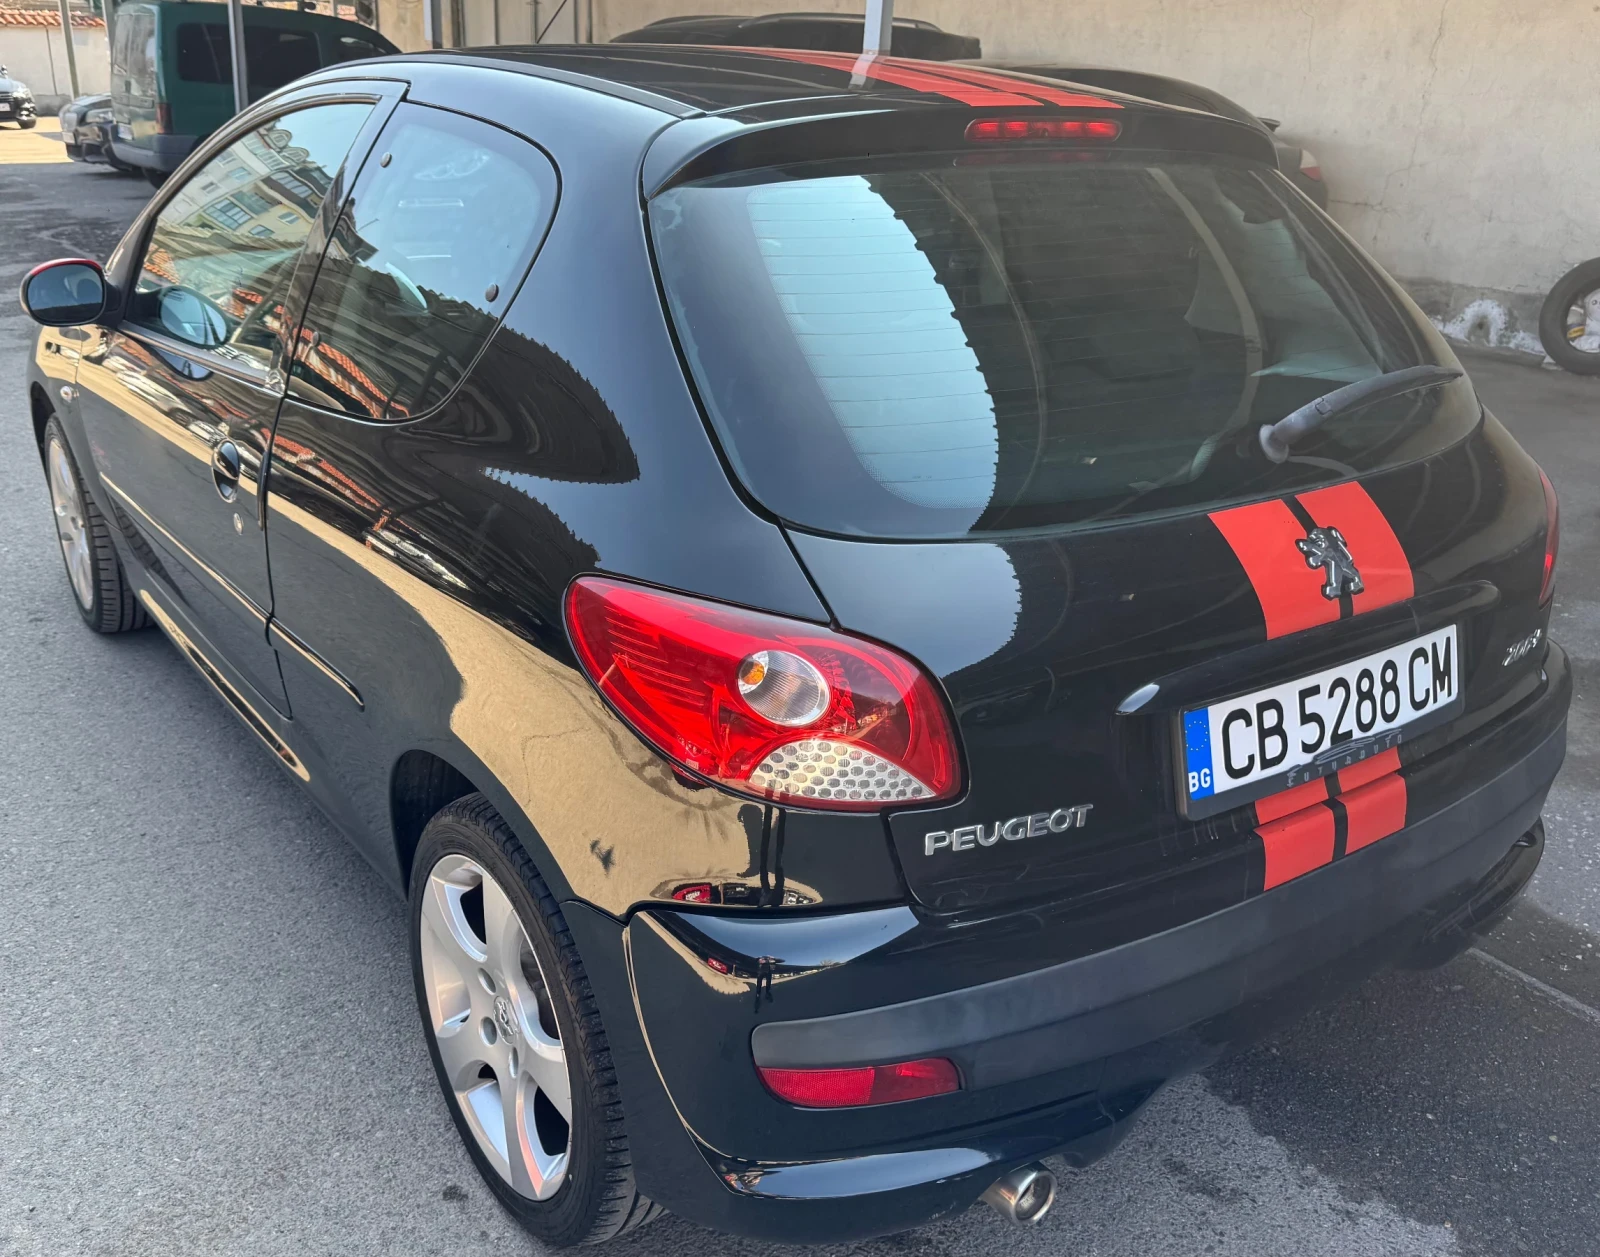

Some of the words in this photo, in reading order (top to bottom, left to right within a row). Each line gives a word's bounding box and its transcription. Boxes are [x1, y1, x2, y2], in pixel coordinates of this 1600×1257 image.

[1222, 698, 1288, 779] CB
[1298, 660, 1401, 753] 5288
[1409, 636, 1452, 711] CM
[1188, 767, 1211, 793] BG
[924, 804, 1094, 856] PEUGEOT
